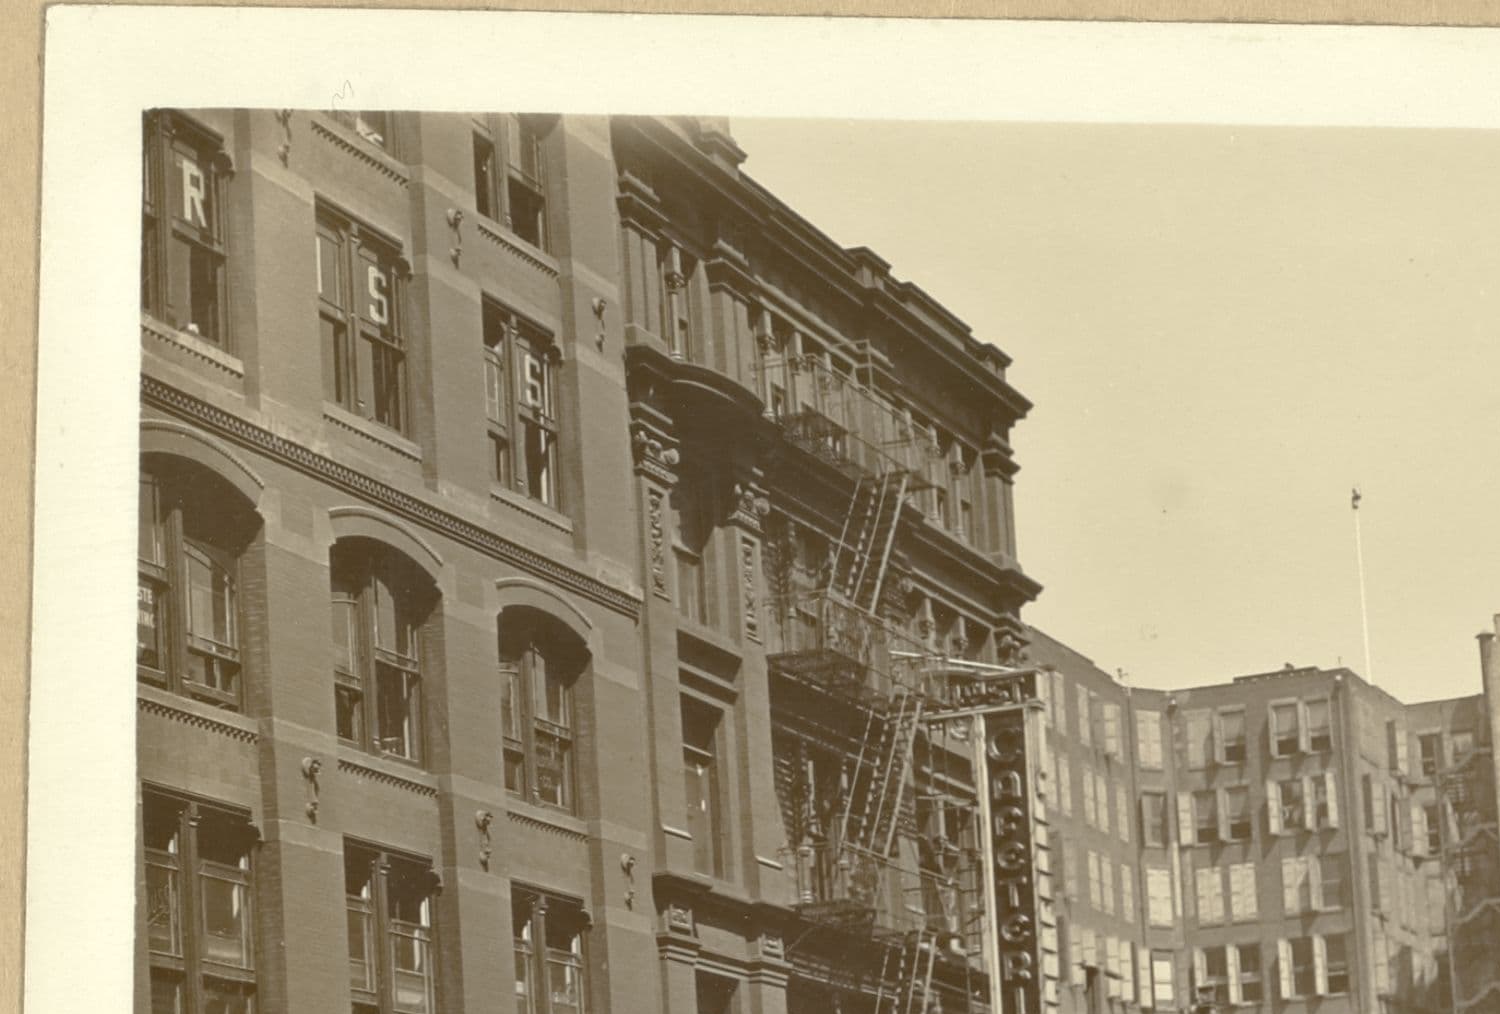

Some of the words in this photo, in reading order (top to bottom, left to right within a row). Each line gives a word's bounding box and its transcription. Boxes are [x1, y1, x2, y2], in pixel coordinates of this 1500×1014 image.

[182, 158, 207, 228] R
[367, 265, 388, 326] S
[523, 355, 541, 408] S
